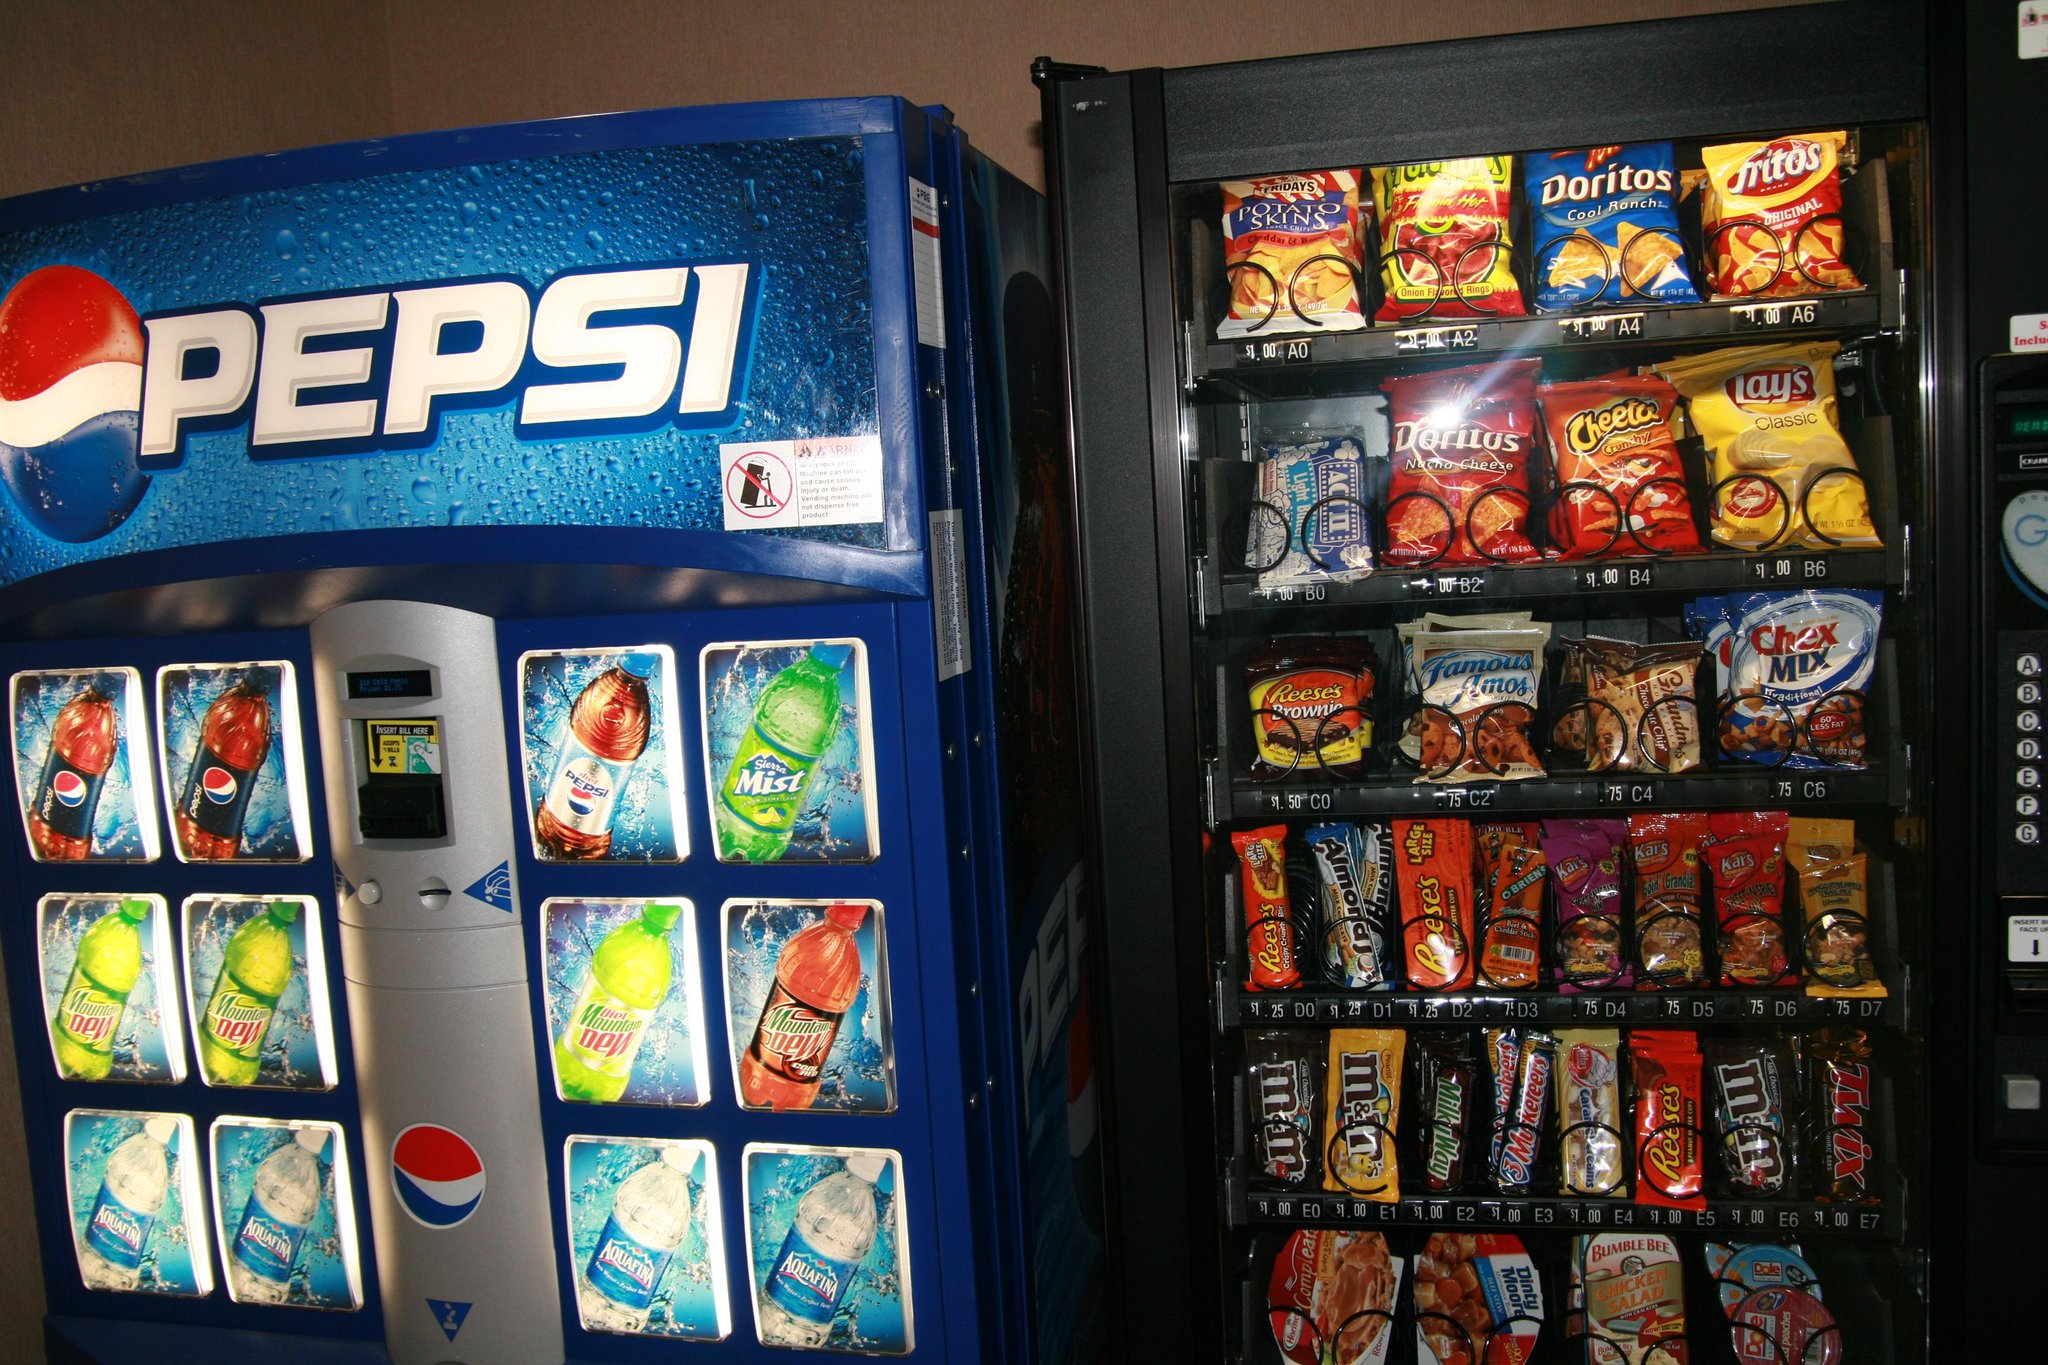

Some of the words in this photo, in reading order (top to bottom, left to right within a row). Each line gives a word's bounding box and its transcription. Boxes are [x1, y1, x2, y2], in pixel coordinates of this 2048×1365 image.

[1263, 180, 1315, 193] FRIDAYS
[1541, 162, 1673, 205] Doritos
[1457, 193, 1488, 208] Hot
[1239, 202, 1341, 222] POTATO
[1566, 205, 1602, 223] Cool
[1607, 197, 1659, 214] Ranch
[1764, 198, 1822, 225] ORIGINAL
[1251, 212, 1329, 230] SKINS
[1400, 287, 1425, 297] Onion
[1466, 284, 1490, 295] Rings
[1791, 305, 1815, 323] A6
[1618, 318, 1640, 335] A4
[1453, 330, 1475, 348] A2
[139, 262, 750, 457] PEPSI
[1288, 342, 1308, 359] A0
[1735, 367, 1810, 403] Lay's
[1755, 411, 1818, 431] Classic
[1603, 431, 1650, 455] Crunchy
[1405, 459, 1453, 472] Nacho
[1460, 458, 1514, 472] Cheese
[1291, 471, 1311, 502] Light
[801, 494, 828, 502] Vending
[802, 511, 830, 519] product.
[1586, 568, 1618, 588] $1.00
[1629, 569, 1651, 586] B4
[1755, 560, 1790, 579] $1.00
[1804, 560, 1826, 578] B6
[1305, 584, 1325, 601] B0
[1460, 576, 1481, 594] B2
[1750, 621, 1839, 656] Chex
[1421, 650, 1533, 691] Famous
[1768, 645, 1836, 684] MIX
[2022, 657, 2034, 673] A
[1269, 683, 1344, 704] Reese's
[1444, 674, 1532, 708] Amos
[1764, 685, 1823, 703] Traditional
[2022, 685, 2033, 701] B
[1271, 700, 1344, 720] Brownie
[376, 725, 397, 735] INSERT
[399, 727, 411, 735] BILL
[413, 727, 429, 735] HERE
[1810, 721, 1830, 731] LESS
[1831, 720, 1845, 729] FAT
[2022, 713, 2033, 729] C
[1652, 726, 1668, 751] Chip
[2022, 742, 2033, 757] D
[753, 758, 788, 774] Sierra
[565, 769, 609, 798] PEPSI
[733, 769, 808, 796] Mist
[2022, 770, 2033, 785] E
[1470, 790, 1491, 806] C2
[1632, 785, 1653, 802] C4
[1803, 781, 1826, 799] C6
[42, 785, 54, 821] pepsi
[189, 783, 202, 819] pepsi
[1271, 794, 1301, 811] $1.50
[1311, 793, 1331, 810] C0
[2022, 798, 2033, 812] F
[2021, 825, 2032, 841] G
[1406, 824, 1425, 863] LARGE
[1421, 832, 1434, 856] SIZE
[1634, 842, 1669, 861] Kar's
[1555, 856, 1588, 881] Kar's
[1721, 853, 1755, 873] Kar's
[1414, 874, 1449, 977] Reese's
[2013, 918, 2040, 926] INSERT
[579, 1002, 642, 1032] Mountain
[599, 1007, 628, 1020] Diet
[1250, 1001, 1284, 1018] $1.25
[1295, 1002, 1315, 1018] D0
[1330, 1001, 1360, 1017] $1.25
[1373, 1002, 1392, 1018] D1
[1409, 1002, 1438, 1018] $1.25
[1452, 1003, 1473, 1018] D2
[1517, 1002, 1538, 1017] D3
[1605, 1001, 1626, 1017] D4
[1692, 1001, 1714, 1017] D5
[1775, 1001, 1797, 1017] D6
[1860, 1001, 1882, 1016] D7
[769, 1007, 830, 1035] Mountain
[1385, 1053, 1393, 1079] Peanut
[1650, 1082, 1681, 1181] Reese's
[1830, 1063, 1873, 1190] Twix
[1427, 1132, 1460, 1181] Way
[1503, 1157, 1523, 1180] 3
[1260, 1201, 1291, 1217] $1.00
[1302, 1203, 1321, 1218] E0
[1336, 1203, 1366, 1218] $1.00
[1380, 1205, 1396, 1219] E1
[1413, 1206, 1443, 1220] $1.00
[1457, 1209, 1475, 1223] E2
[1492, 1206, 1521, 1223] $1.00
[1535, 1209, 1553, 1223] E3
[1570, 1208, 1601, 1224] $1.00
[1614, 1209, 1633, 1224] E4
[1650, 1209, 1681, 1225] $1.00
[1696, 1210, 1715, 1226] E5
[1732, 1209, 1764, 1224] $1.00
[1779, 1211, 1799, 1227] E6
[93, 1203, 142, 1250] AQUAFINA
[1814, 1210, 1848, 1227] $1.00
[1860, 1214, 1879, 1229] E7
[242, 1215, 292, 1261] AQUAFINA
[1591, 1240, 1645, 1262] BUMBLE
[1646, 1238, 1671, 1252] BEE
[598, 1238, 655, 1288] AQUAFINA
[1753, 1262, 1781, 1275] Dole
[779, 1250, 839, 1302] AQUAFINA
[1595, 1265, 1668, 1301] CHICKEN
[1500, 1265, 1526, 1317] Moore
[1515, 1265, 1539, 1310] Dinty
[1607, 1286, 1665, 1314] SALAD
[1633, 1303, 1659, 1315] CRACKERS
[1781, 1311, 1791, 1349] peaches
